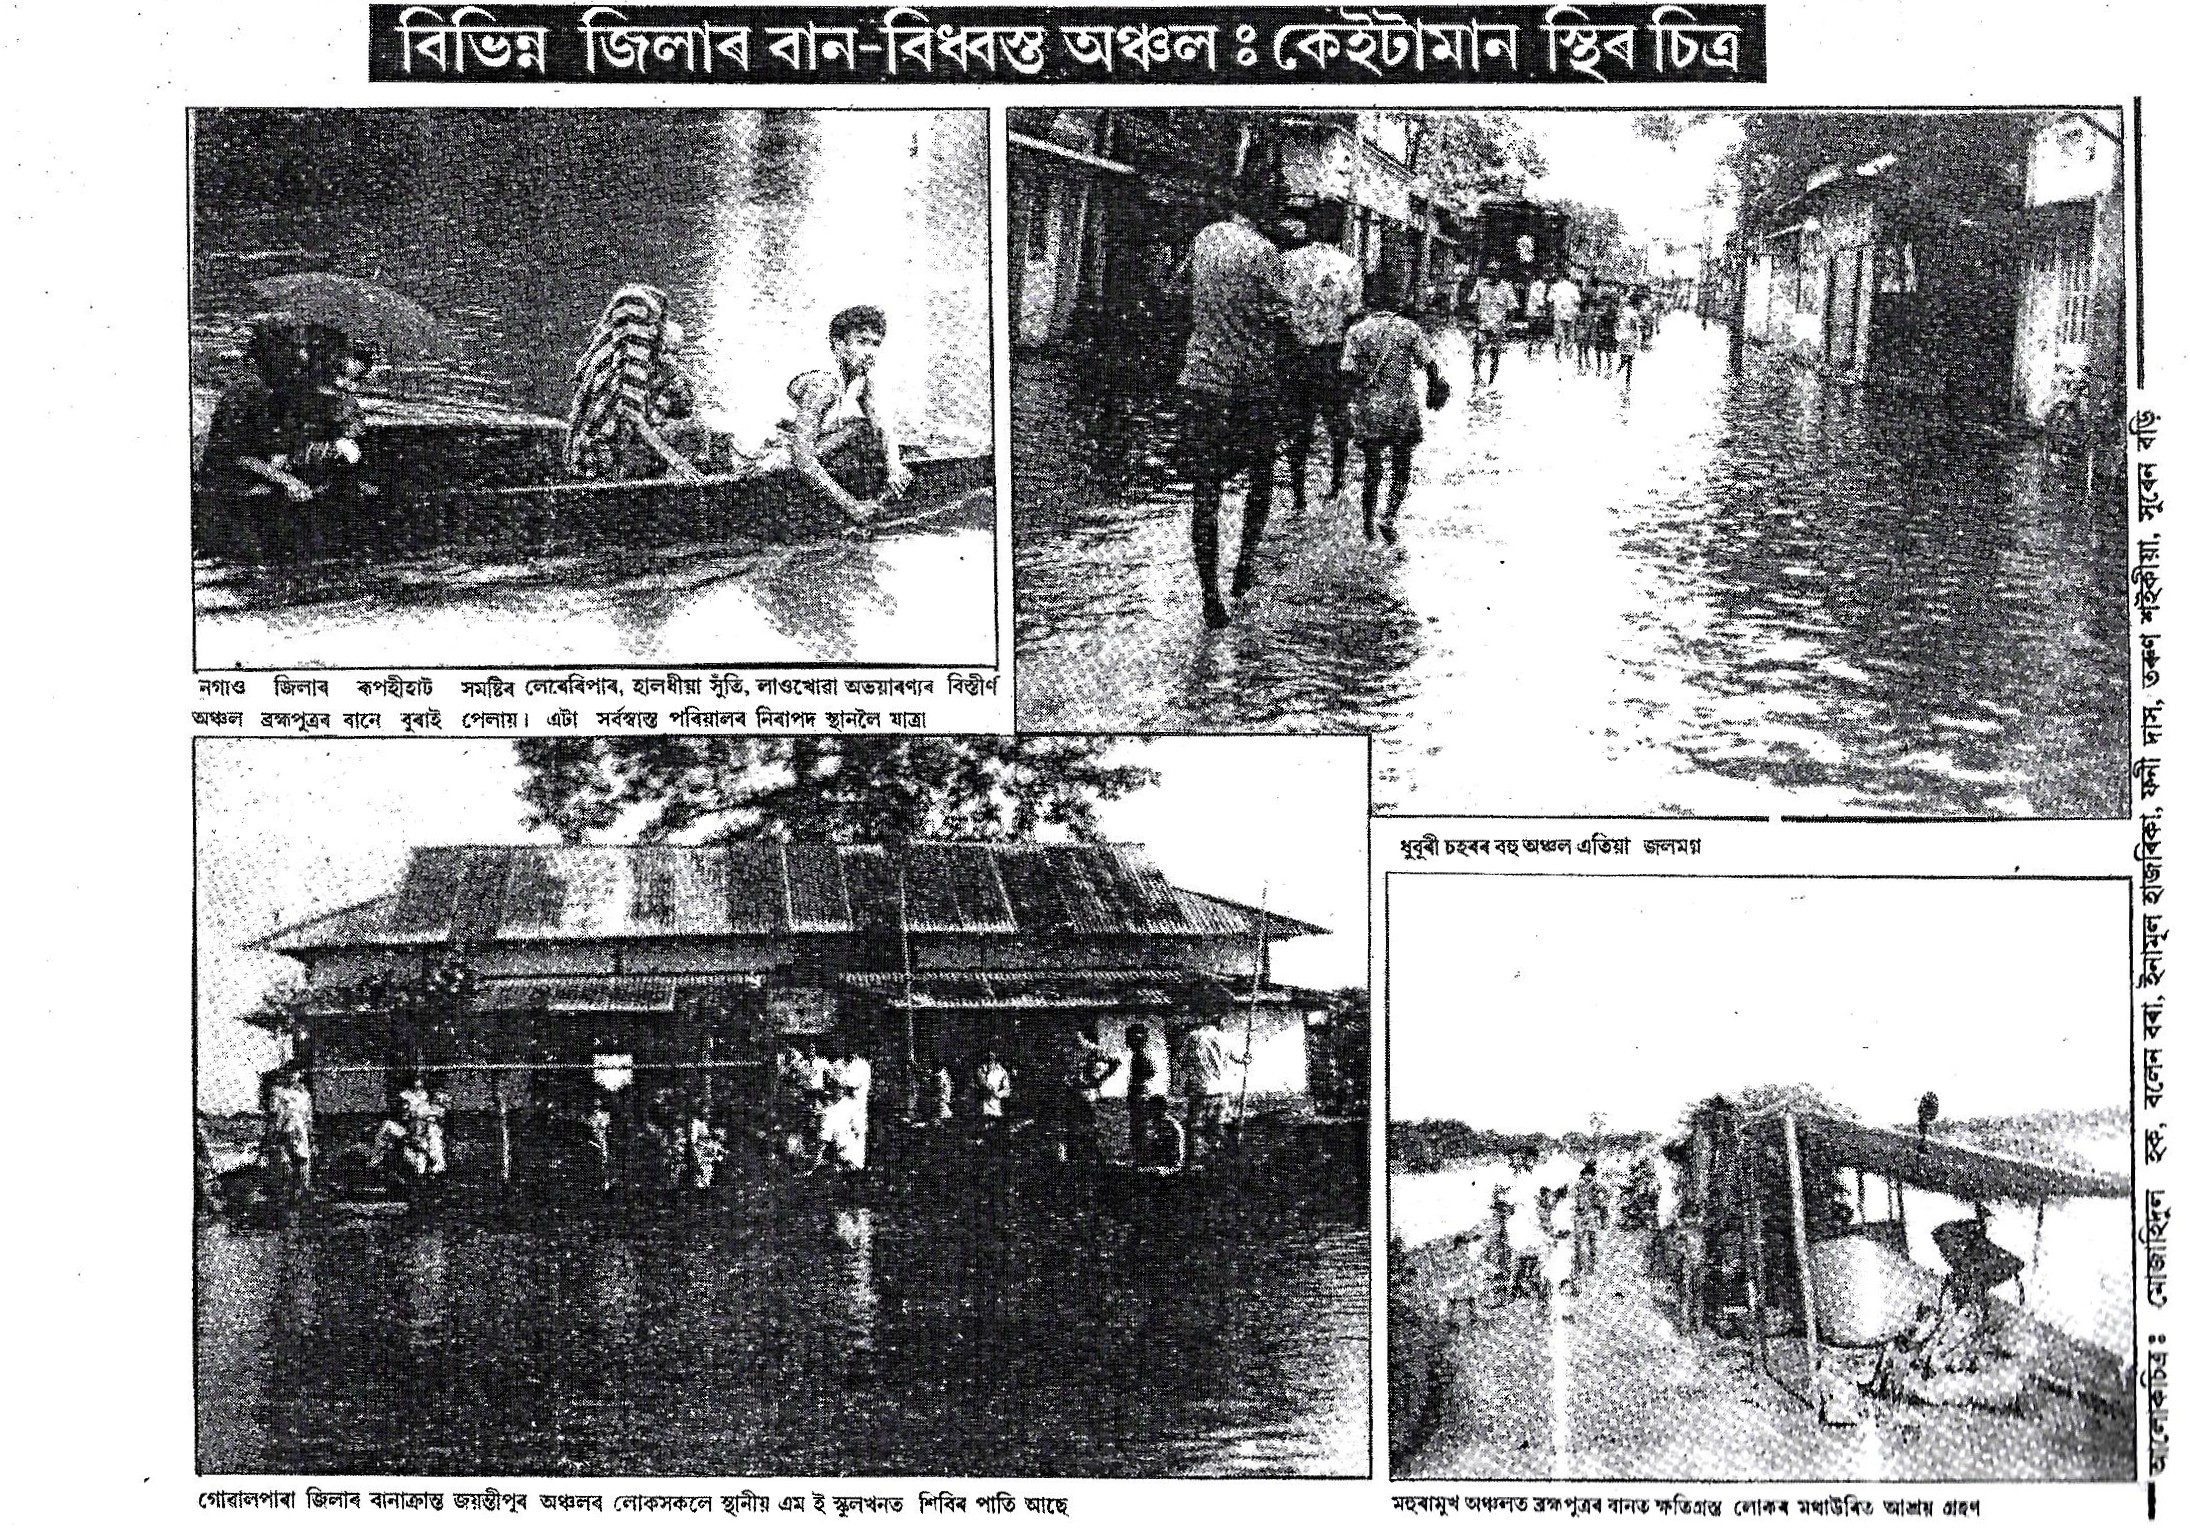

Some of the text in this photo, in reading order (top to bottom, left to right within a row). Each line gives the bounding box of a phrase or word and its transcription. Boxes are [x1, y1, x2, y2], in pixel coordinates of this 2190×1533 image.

[394, 7, 549, 74] বিভিন্ন
[578, 7, 751, 73] জিলাৰ
[1060, 23, 1219, 73] অঞ্চল
[1273, 7, 1521, 76] কেইটামান
[1540, 5, 1637, 82] স্থিৰ
[1647, 5, 1743, 73] চিত্ৰ
[273, 674, 328, 697] জিলাৰ
[191, 710, 243, 728] অঞ্চল
[261, 711, 330, 732] ব্ৰহ্মপুত্ৰৰ
[343, 711, 381, 729] বানে
[547, 707, 578, 729] এটা
[669, 706, 746, 728] পৰিয়ালৰ
[756, 705, 816, 728] নিৰাপদ
[825, 707, 880, 732] স্থানলৈ
[889, 711, 926, 729] যাত্ৰা
[1444, 840, 1490, 857] চহৰৰ
[1494, 839, 1519, 857] বহু
[1522, 838, 1571, 856] অঞ্চল
[1577, 832, 1631, 856] এতিয়া
[2143, 1048, 2163, 1110] বলেন
[199, 1490, 296, 1509] গোৱালপাৰা
[306, 1487, 360, 1510] জিলাৰ
[539, 1493, 603, 1512] অঞ্চলৰ
[614, 1494, 713, 1513] লোকসকলে
[720, 1489, 770, 1517] স্থানীয়
[778, 1496, 806, 1513] এম
[812, 1491, 827, 1515] ই
[919, 1490, 967, 1514] শিবিৰ
[976, 1491, 1016, 1515] পাতি
[1023, 1497, 1070, 1518] আছে
[1608, 1497, 1649, 1515] বানত
[1734, 1499, 1788, 1516] লোকৰ
